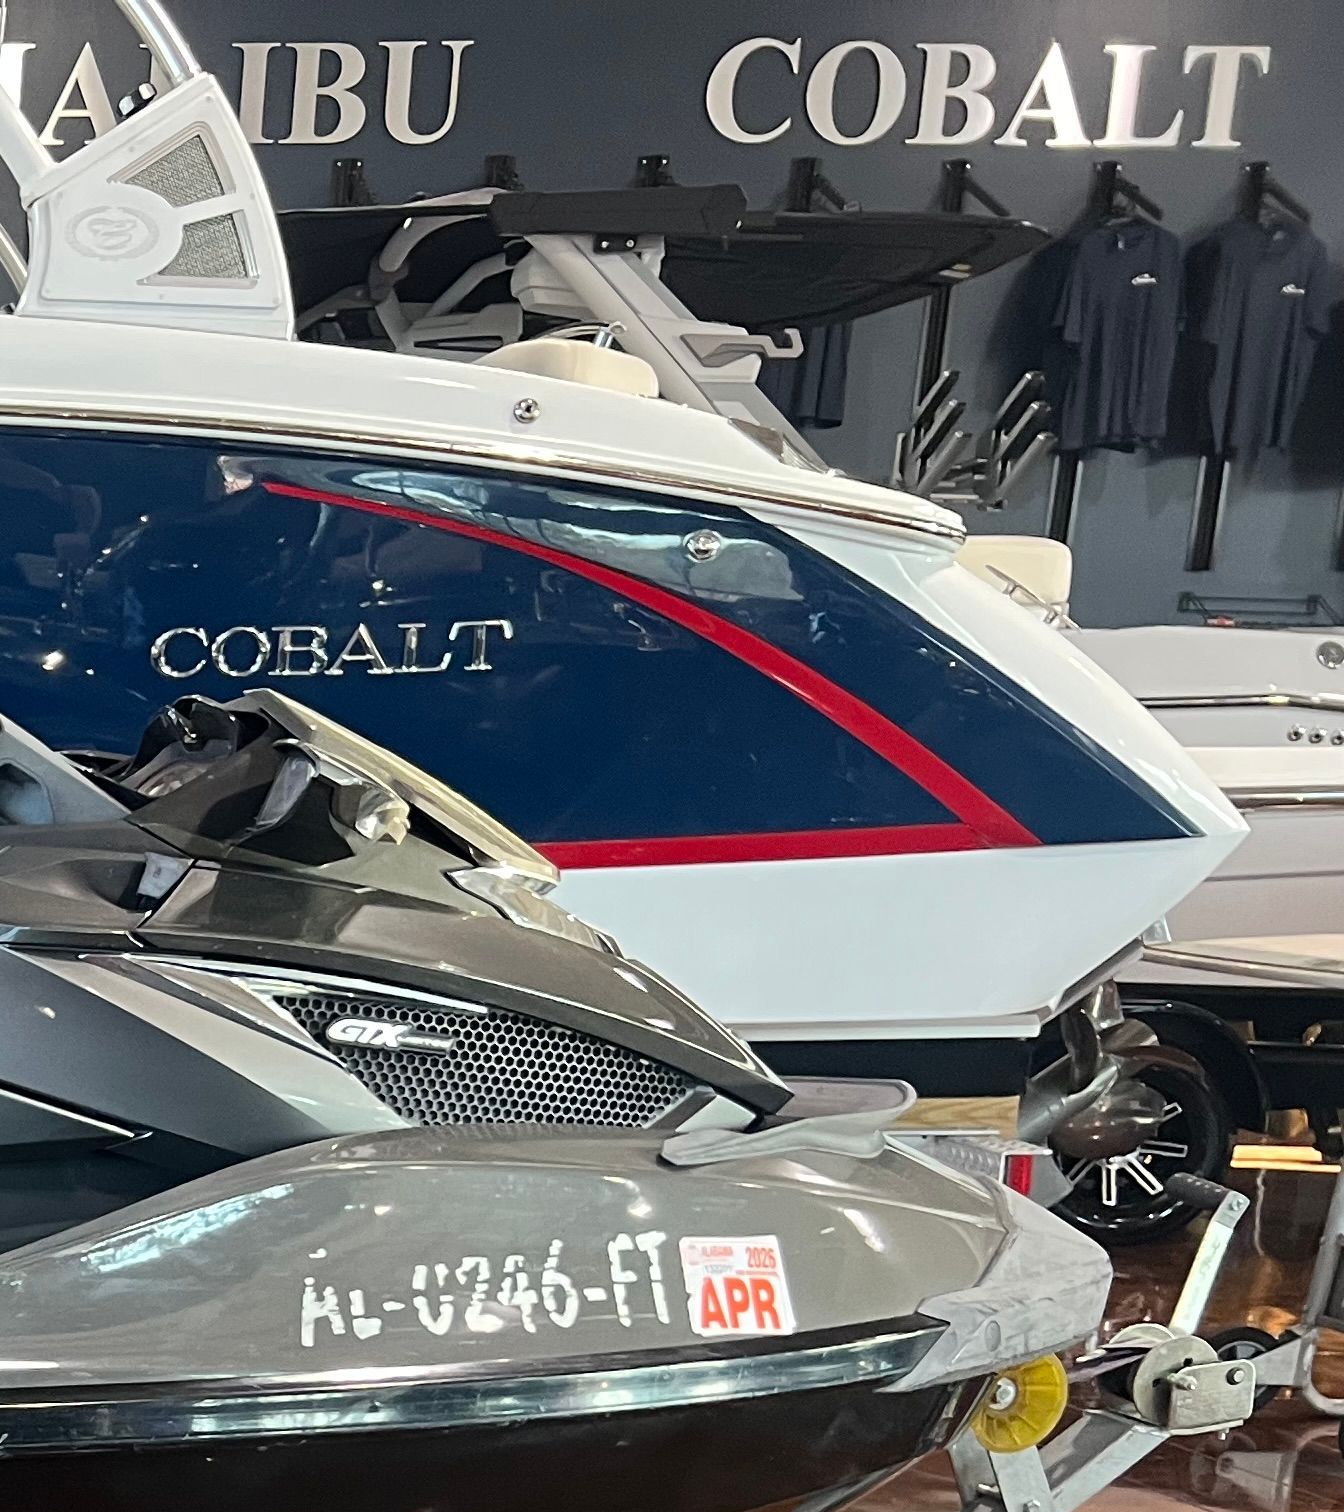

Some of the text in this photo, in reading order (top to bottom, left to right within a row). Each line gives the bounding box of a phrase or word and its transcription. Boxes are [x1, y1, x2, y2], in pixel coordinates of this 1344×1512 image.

[706, 37, 1271, 147] COBALT
[150, 618, 512, 678] COBALT
[327, 1018, 412, 1048] GTX
[746, 1246, 777, 1268] 2026
[701, 1276, 782, 1329] APR
